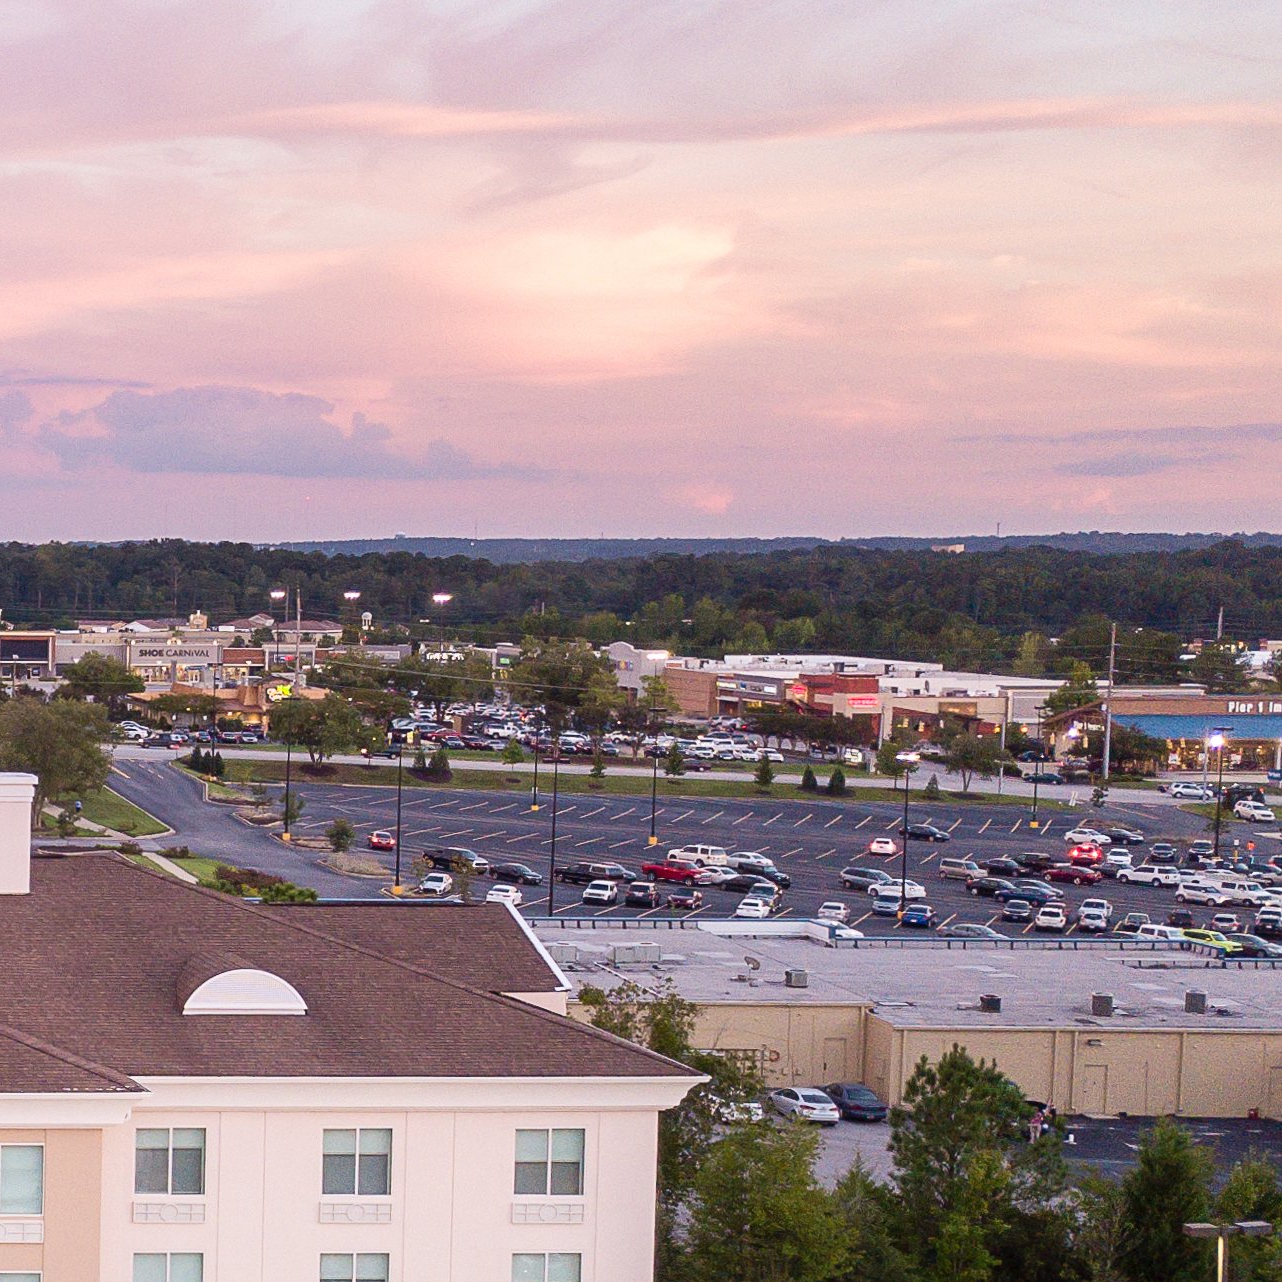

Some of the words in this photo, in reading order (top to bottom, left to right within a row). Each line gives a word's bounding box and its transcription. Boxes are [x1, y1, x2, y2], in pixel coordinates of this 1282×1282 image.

[138, 649, 164, 657] SHOE
[165, 649, 210, 657] CARNIVAL
[1228, 701, 1254, 713] Pier
[1258, 701, 1264, 713] 1
